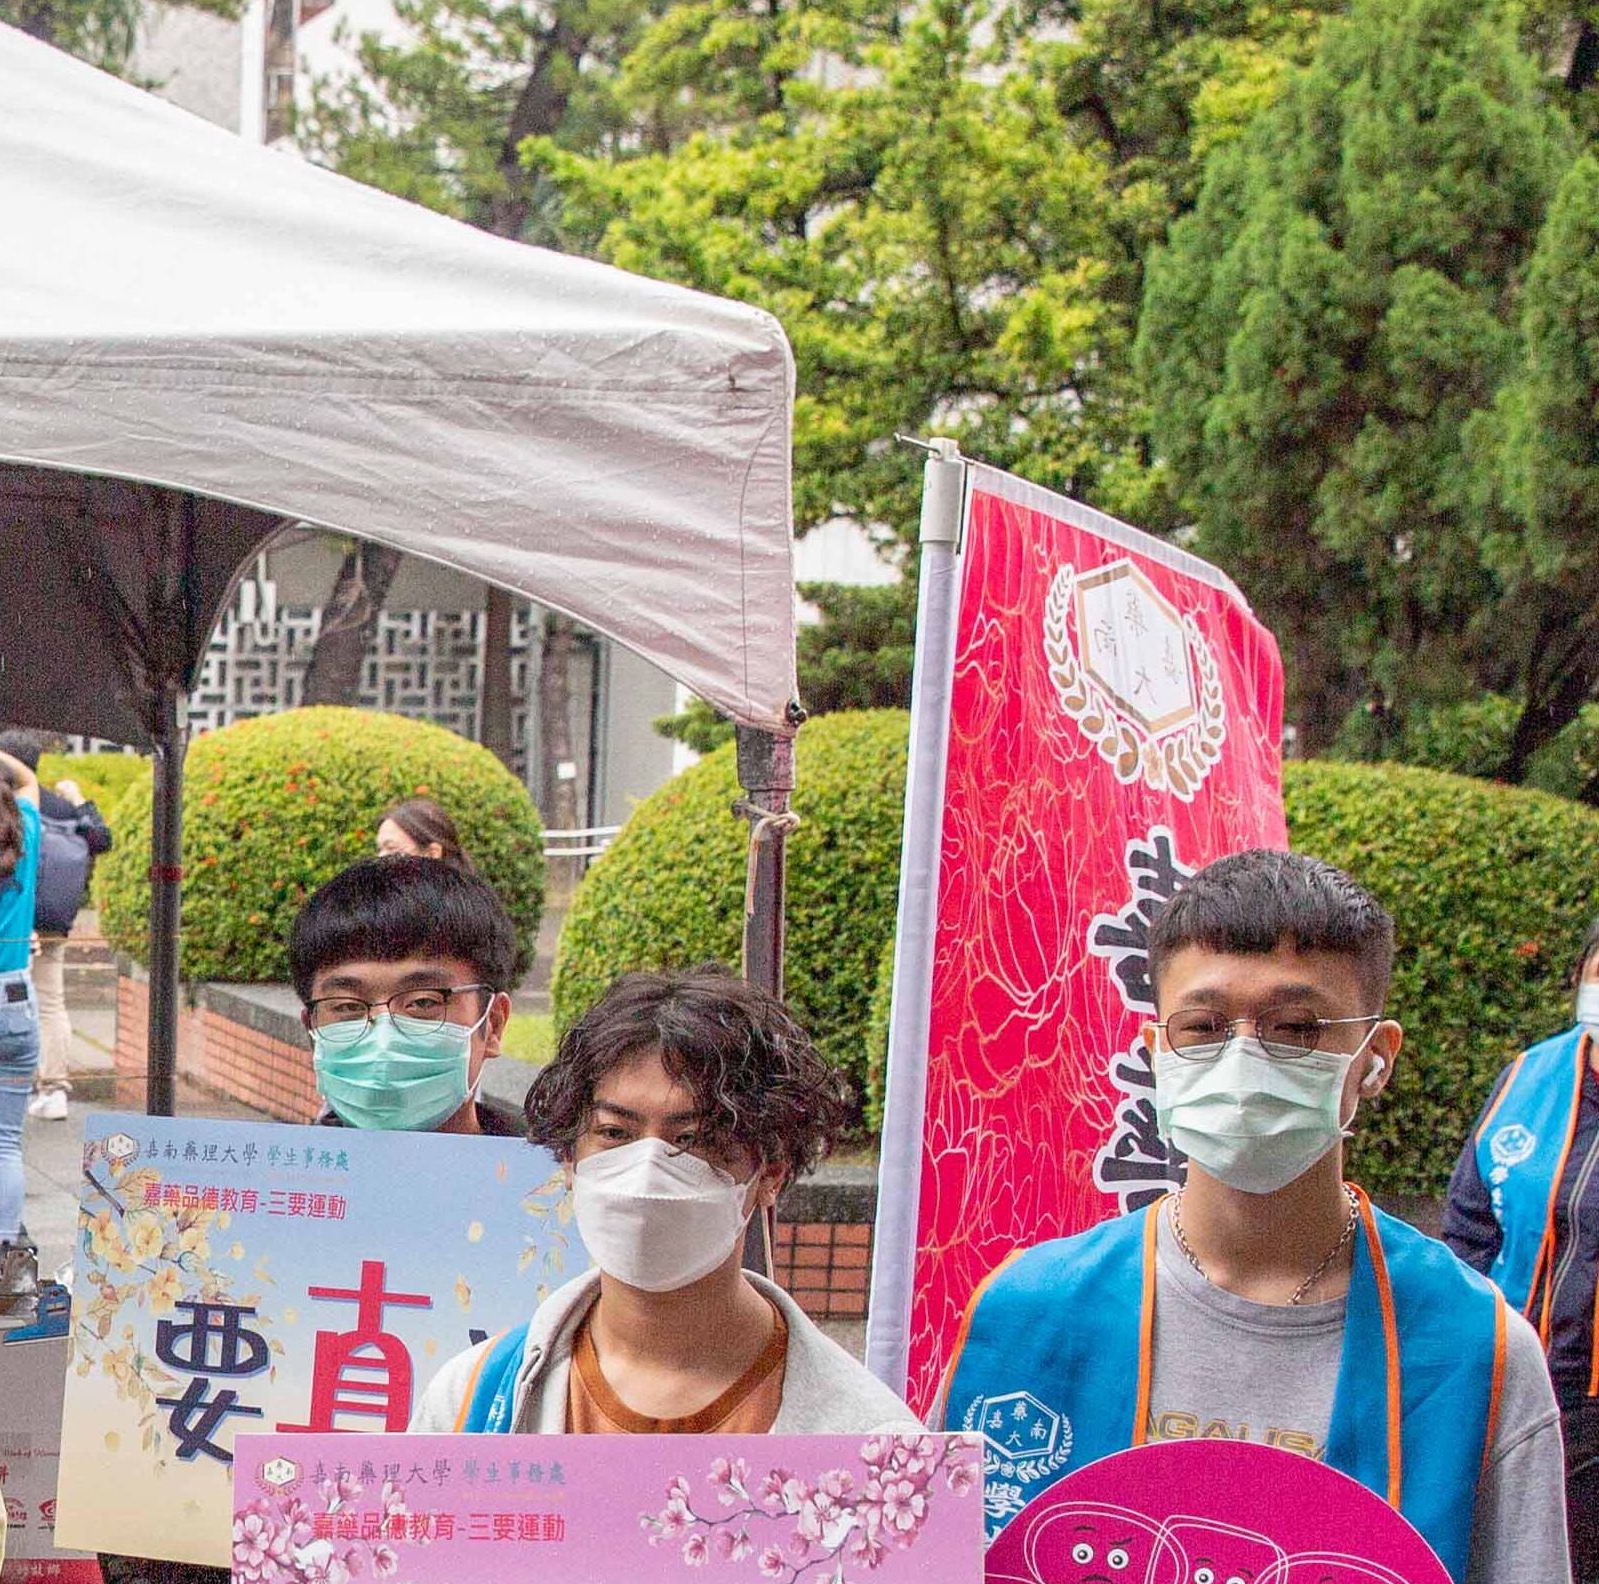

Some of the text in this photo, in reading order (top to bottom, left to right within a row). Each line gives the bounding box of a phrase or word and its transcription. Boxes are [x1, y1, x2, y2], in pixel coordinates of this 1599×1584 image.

[144, 1137, 259, 1167] 嘉南藥理大學
[143, 1182, 348, 1221] 嘉藥品德教育-三要運動
[154, 1259, 487, 1466] 要真
[309, 1459, 452, 1487] 嘉南藥理大學
[312, 1511, 566, 1543] 嘉藥品德教育-三要運動
